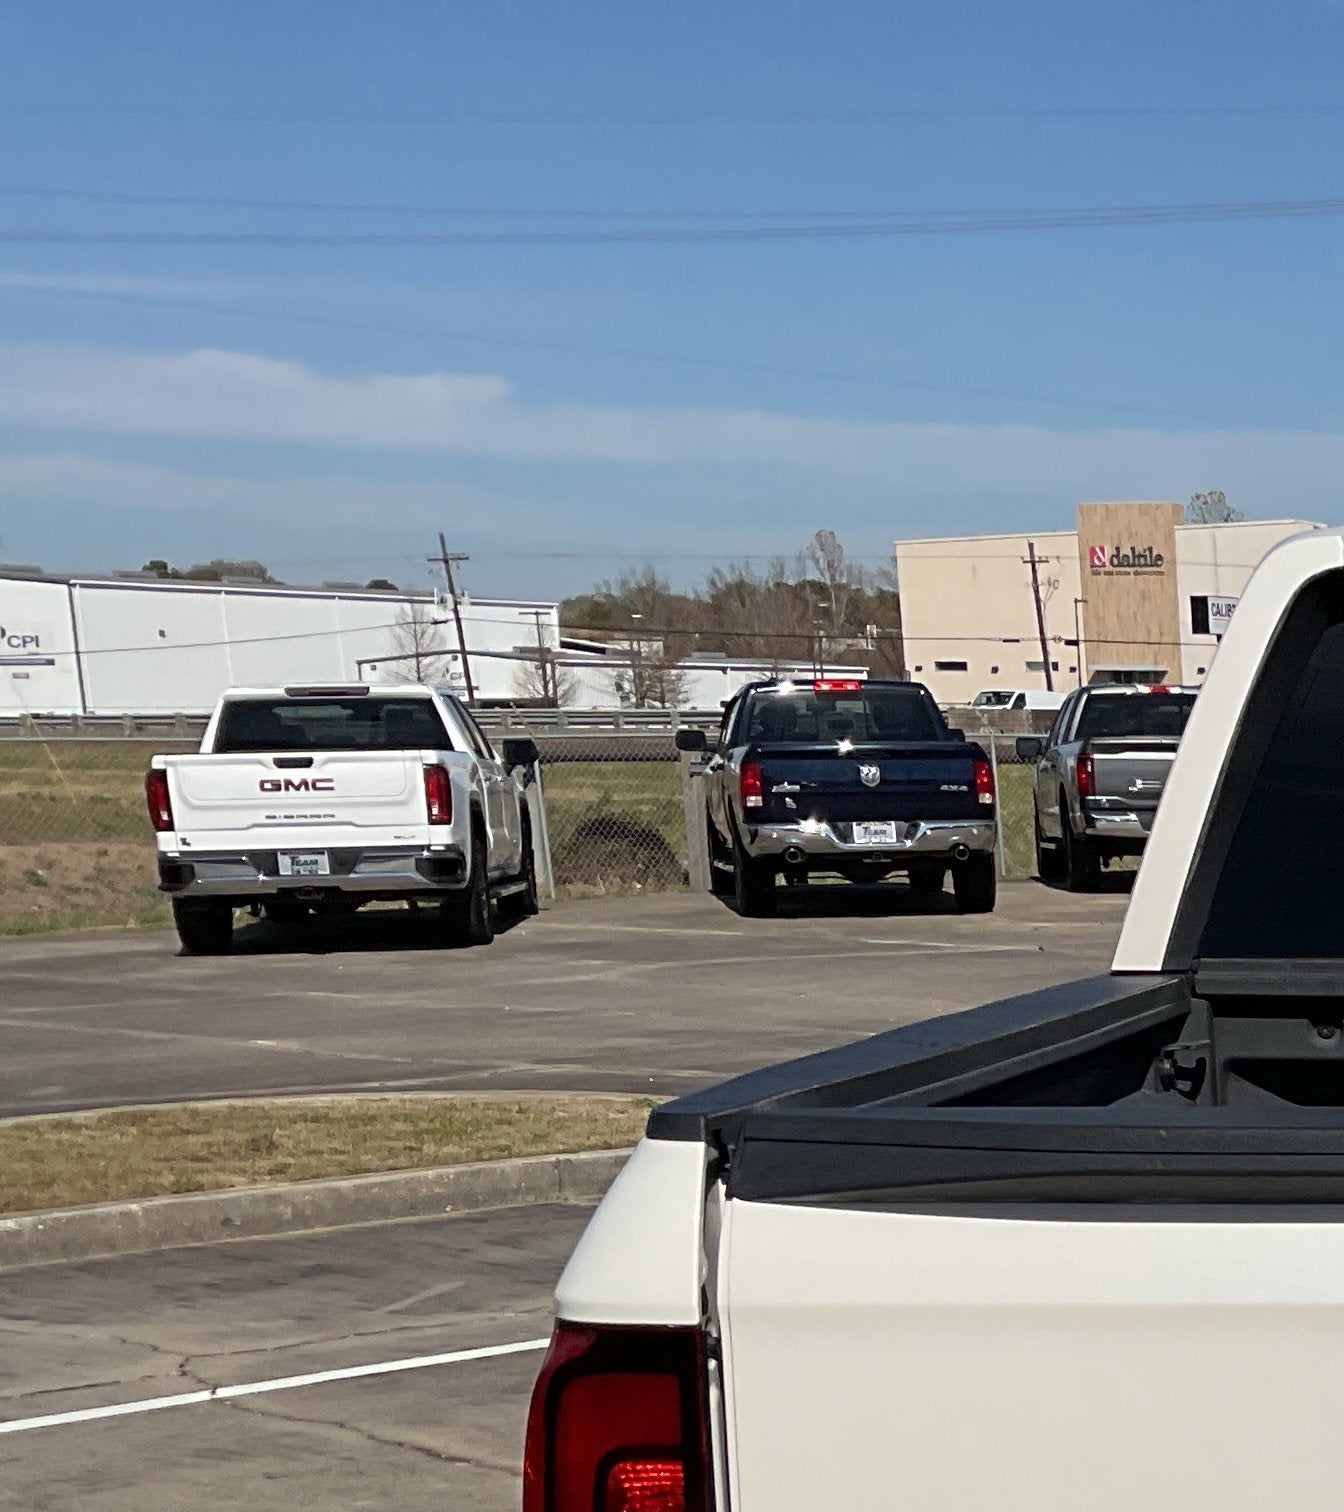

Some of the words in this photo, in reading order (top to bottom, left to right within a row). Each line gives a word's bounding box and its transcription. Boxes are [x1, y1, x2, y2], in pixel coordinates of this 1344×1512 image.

[1110, 546, 1164, 567] daltile
[7, 635, 40, 648] CPI
[260, 778, 335, 792] GMC
[290, 856, 319, 867] TEAM
